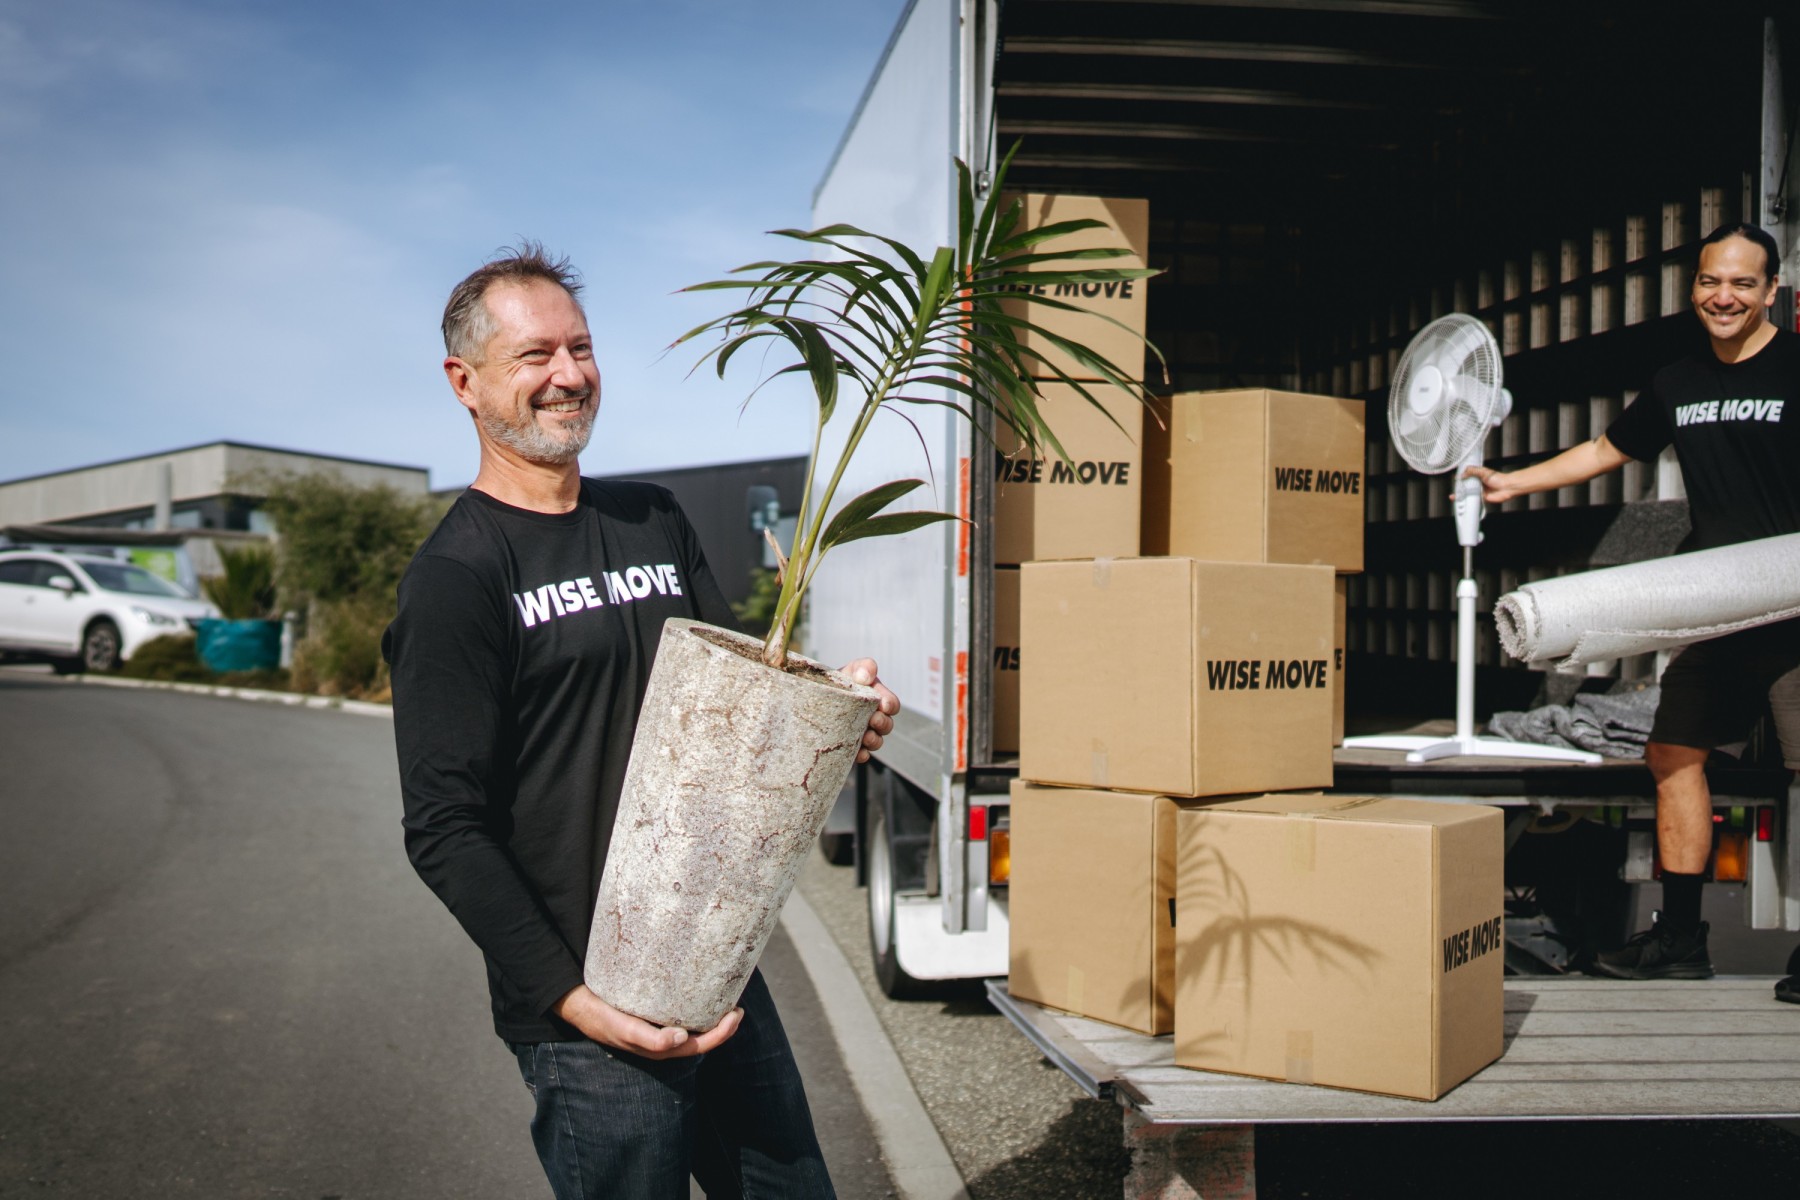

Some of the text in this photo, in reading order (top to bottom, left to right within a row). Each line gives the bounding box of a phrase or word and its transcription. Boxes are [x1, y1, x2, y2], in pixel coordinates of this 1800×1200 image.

[1054, 278, 1134, 299] MOVE
[1676, 399, 1784, 427] WISE MOVE
[1050, 460, 1130, 485] MOVE
[1275, 467, 1360, 494] WISE MOVE
[513, 564, 682, 627] WISE MOVE
[1207, 660, 1327, 690] WISE MOVE
[1443, 916, 1501, 973] WISE MOVE
